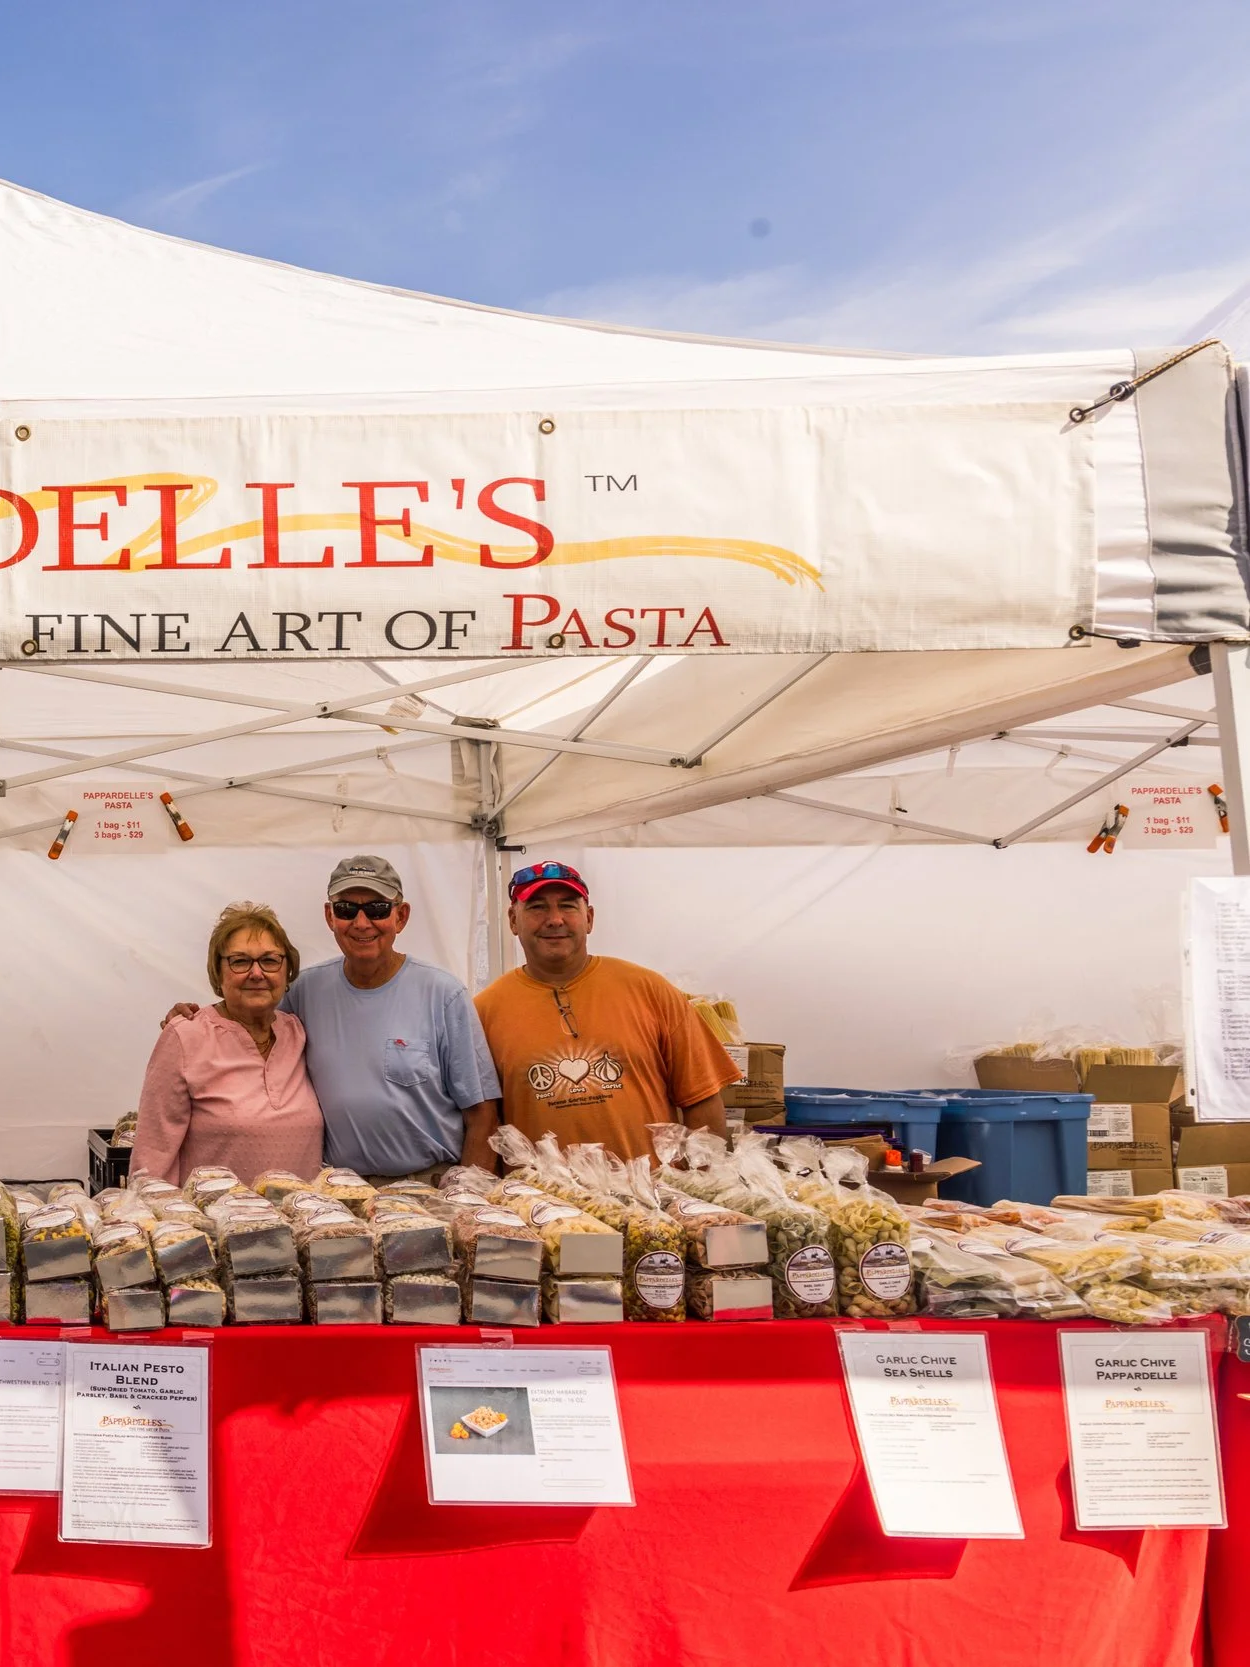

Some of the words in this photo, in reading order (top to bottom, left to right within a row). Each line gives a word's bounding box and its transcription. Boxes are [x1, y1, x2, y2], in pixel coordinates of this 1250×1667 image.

[584, 474, 638, 492] TM
[25, 612, 191, 654] FINE
[213, 611, 362, 652] ART
[384, 609, 477, 651] OF
[501, 593, 731, 651] PASTA
[1131, 786, 1203, 795] PAPPARDELLE'S
[83, 791, 154, 800] PAPPARDELLE'S
[104, 801, 133, 809] PASTA
[1153, 816, 1169, 825] bag
[1176, 816, 1190, 824] $11
[96, 821, 101, 829] 1
[103, 821, 120, 830] bag
[126, 821, 141, 829] $11
[1143, 826, 1149, 834] 3
[1151, 826, 1172, 835] bags
[1179, 826, 1194, 834] $29
[94, 831, 99, 839] 3
[101, 831, 122, 840] bags
[129, 831, 144, 839] $29
[876, 1355, 918, 1365] GARLIC
[921, 1355, 957, 1365] CHIVE
[1095, 1358, 1137, 1367] GARLIC
[1140, 1358, 1176, 1367] CHIVE
[90, 1361, 140, 1373] ITALIAN
[143, 1363, 185, 1374] PESTO
[884, 1368, 907, 1377] SEA
[910, 1368, 953, 1378] SHELLS
[1096, 1371, 1178, 1380] PAPPARDELLE
[116, 1375, 158, 1386] BLEND
